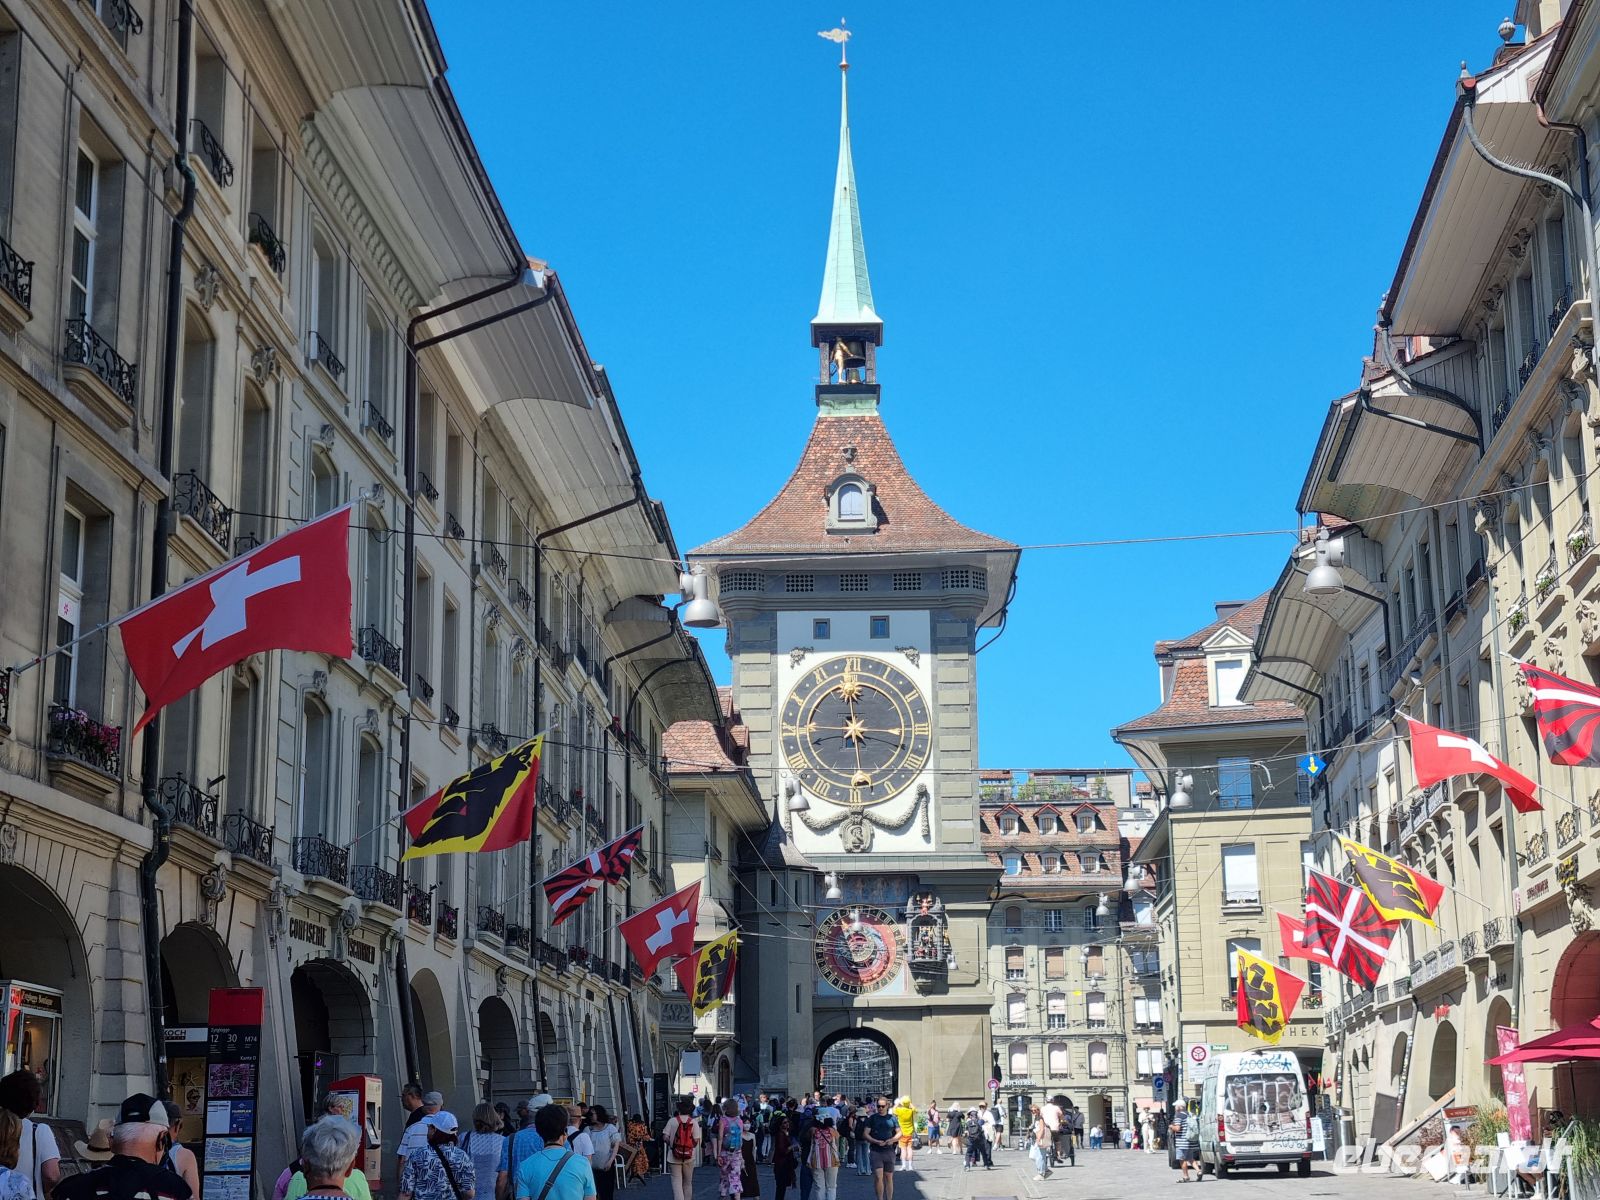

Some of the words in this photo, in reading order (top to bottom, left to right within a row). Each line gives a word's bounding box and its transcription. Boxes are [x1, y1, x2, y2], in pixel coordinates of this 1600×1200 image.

[289, 917, 328, 948] CONFISERIE
[211, 1034, 220, 1043] 12
[227, 1033, 238, 1043] 30
